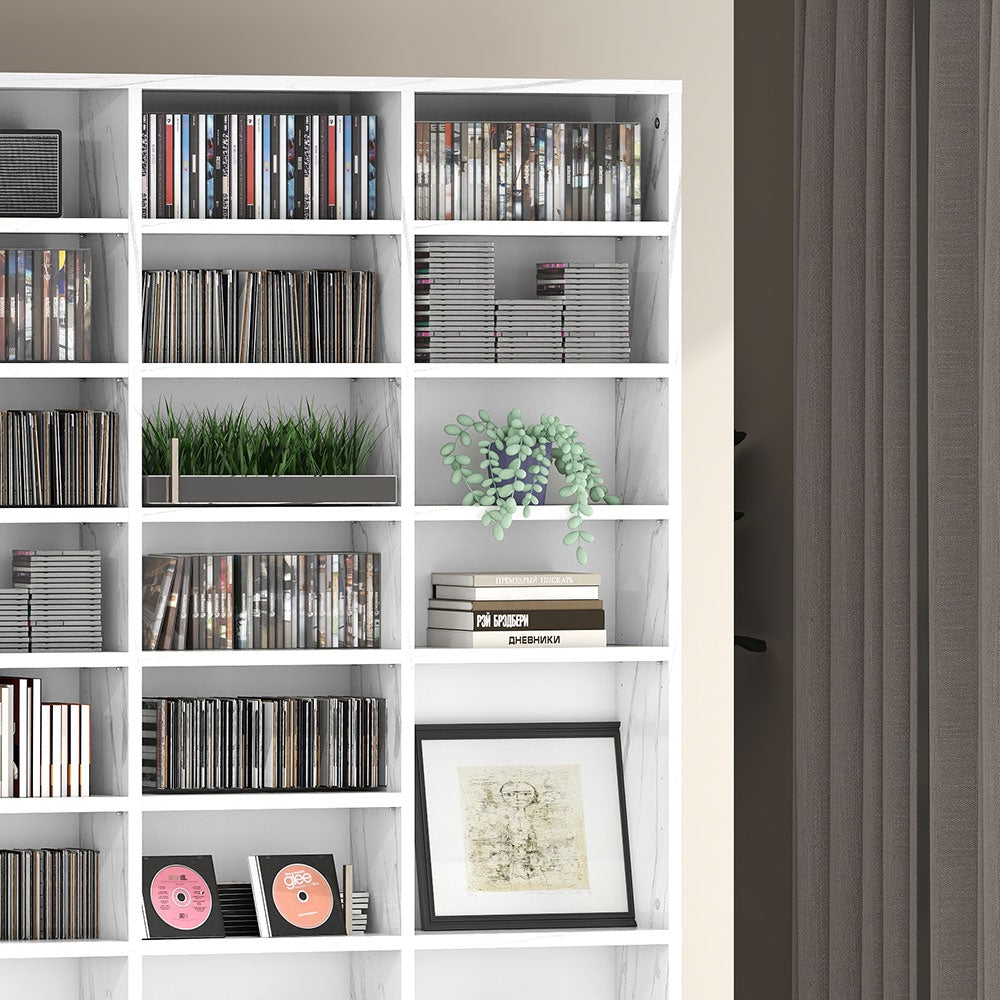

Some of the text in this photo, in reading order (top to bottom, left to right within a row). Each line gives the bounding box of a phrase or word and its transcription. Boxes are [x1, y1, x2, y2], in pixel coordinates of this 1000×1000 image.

[477, 612, 529, 628] РЭЙ БРЭДБЕРИ
[509, 636, 560, 644] ДНЕВНИКИ
[284, 872, 312, 890] glee
